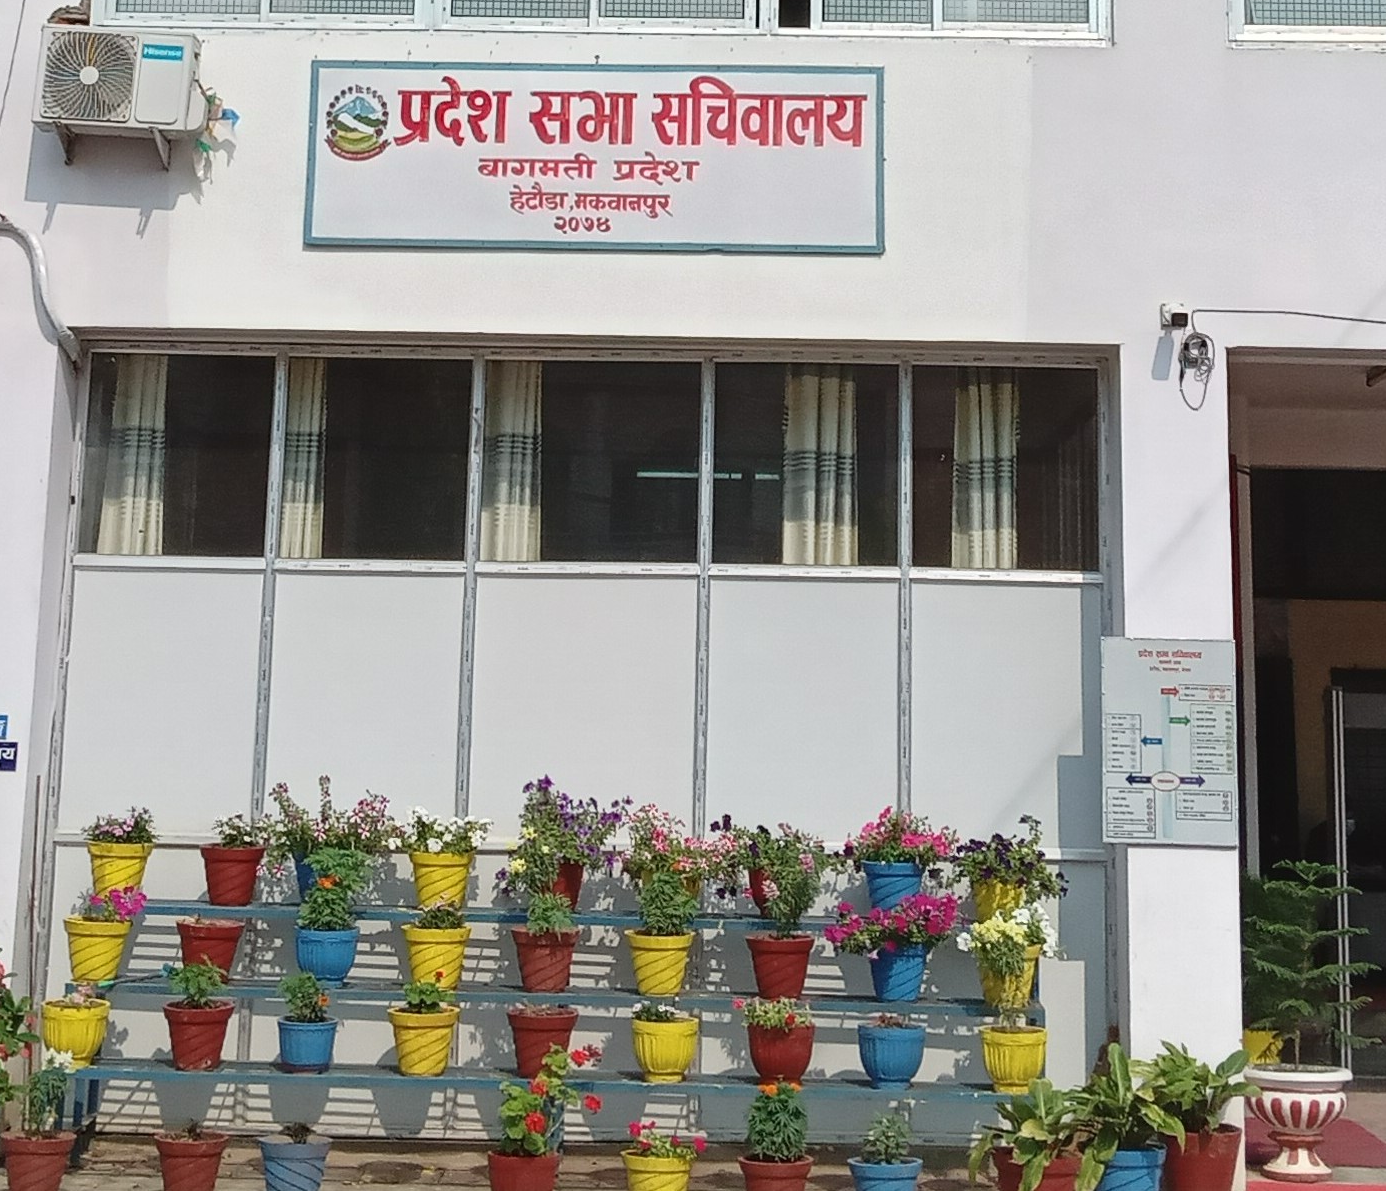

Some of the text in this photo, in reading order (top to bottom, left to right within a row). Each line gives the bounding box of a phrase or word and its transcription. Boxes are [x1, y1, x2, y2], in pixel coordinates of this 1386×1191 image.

[144, 47, 182, 56] Hisense
[394, 75, 867, 148] प्रदेश सभा सचिवालय
[478, 152, 699, 184] बागमती प्रदेश
[554, 216, 612, 233] २०७४
